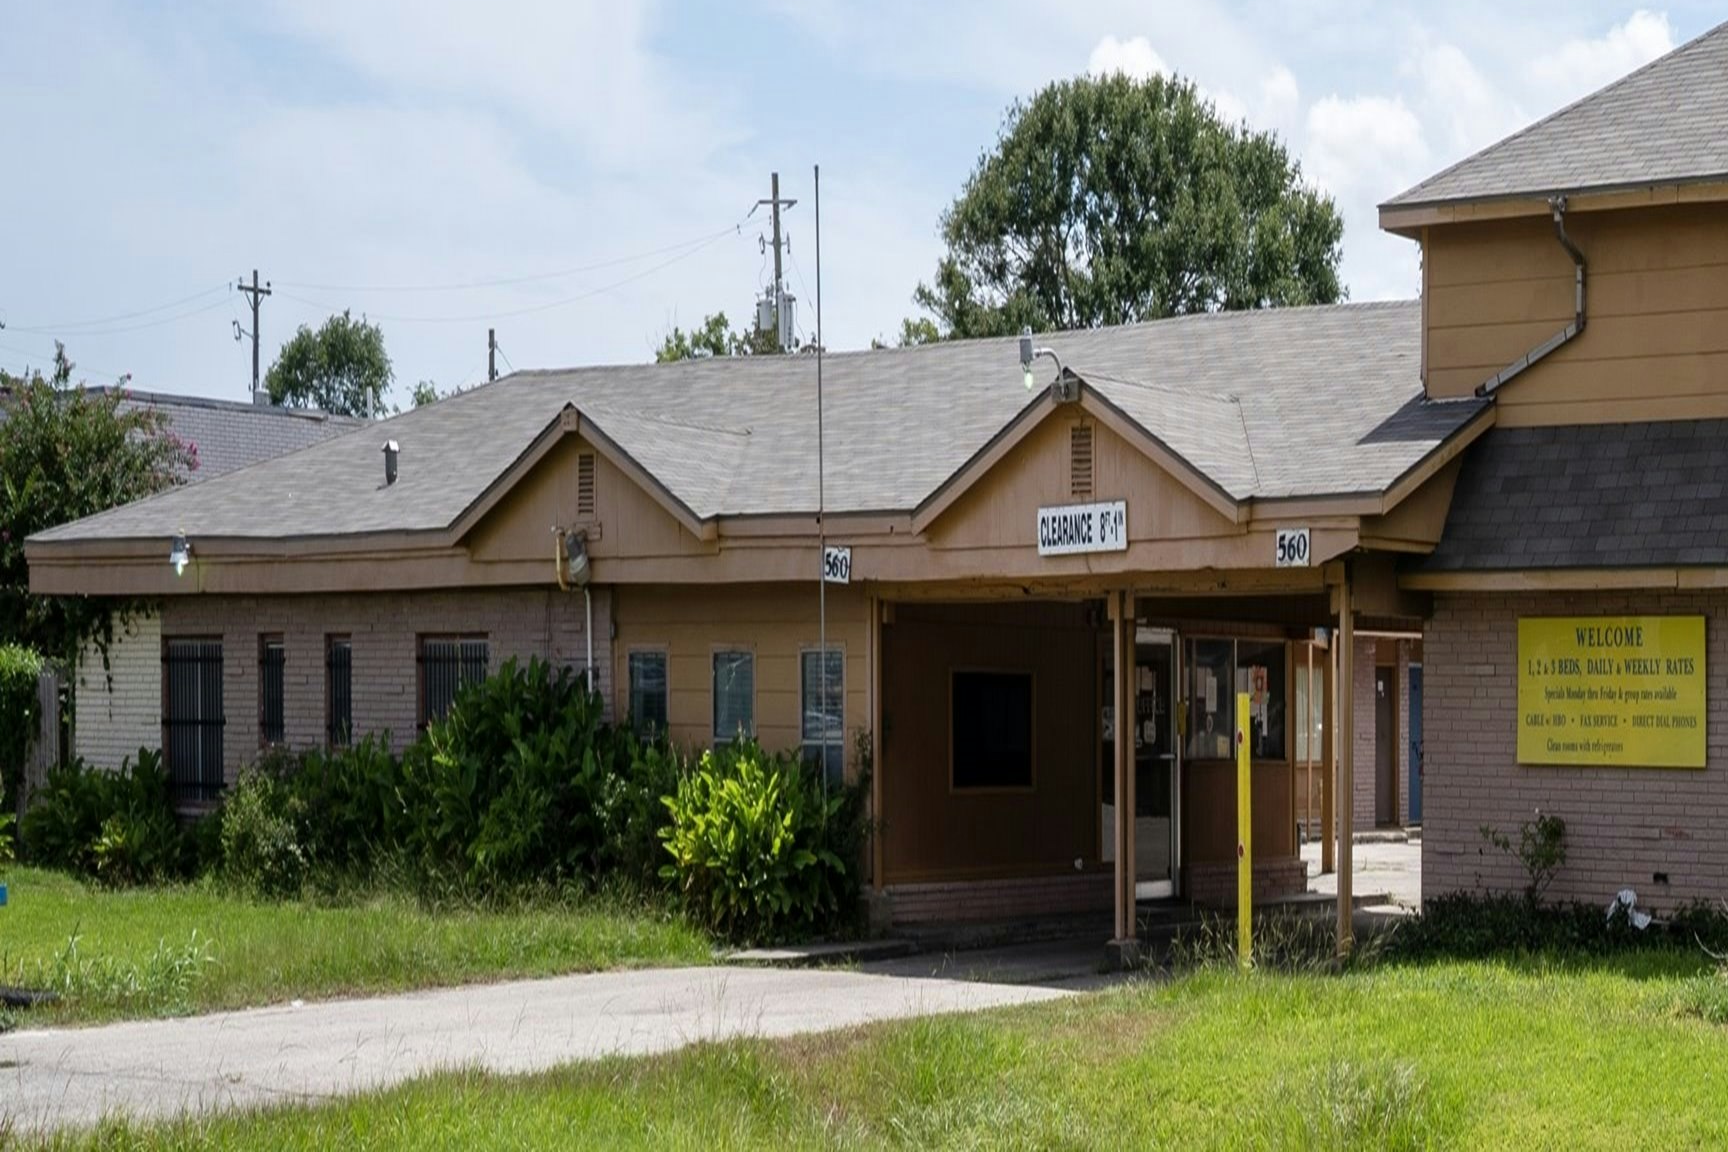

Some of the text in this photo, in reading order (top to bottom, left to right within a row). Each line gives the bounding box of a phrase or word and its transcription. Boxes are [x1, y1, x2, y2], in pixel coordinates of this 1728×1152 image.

[1040, 513, 1092, 548] CLEARANCE
[1278, 533, 1307, 562] 560
[825, 552, 848, 579] 560
[1575, 626, 1643, 647] WELCOME
[1536, 659, 1542, 675] 2
[1558, 659, 1583, 677] BEDS,
[1587, 658, 1615, 675] DAILY
[1624, 658, 1661, 675] WEEKLY
[1666, 658, 1695, 675] RATES
[1566, 686, 1586, 704] Monday
[1600, 686, 1617, 704] Friday
[1625, 690, 1640, 705] group
[1641, 690, 1653, 700] rates
[1654, 686, 1677, 700] available
[1526, 714, 1545, 726] CABLE
[1552, 714, 1567, 726] HBO
[1580, 714, 1592, 726] FAX
[1593, 714, 1619, 726] SERVICE
[1632, 715, 1654, 727] DIRECT
[1655, 715, 1671, 727] DIAL
[1672, 715, 1697, 728] PHONES
[1546, 738, 1562, 752] Clean
[1562, 742, 1578, 752] rooms
[1579, 738, 1591, 752] with
